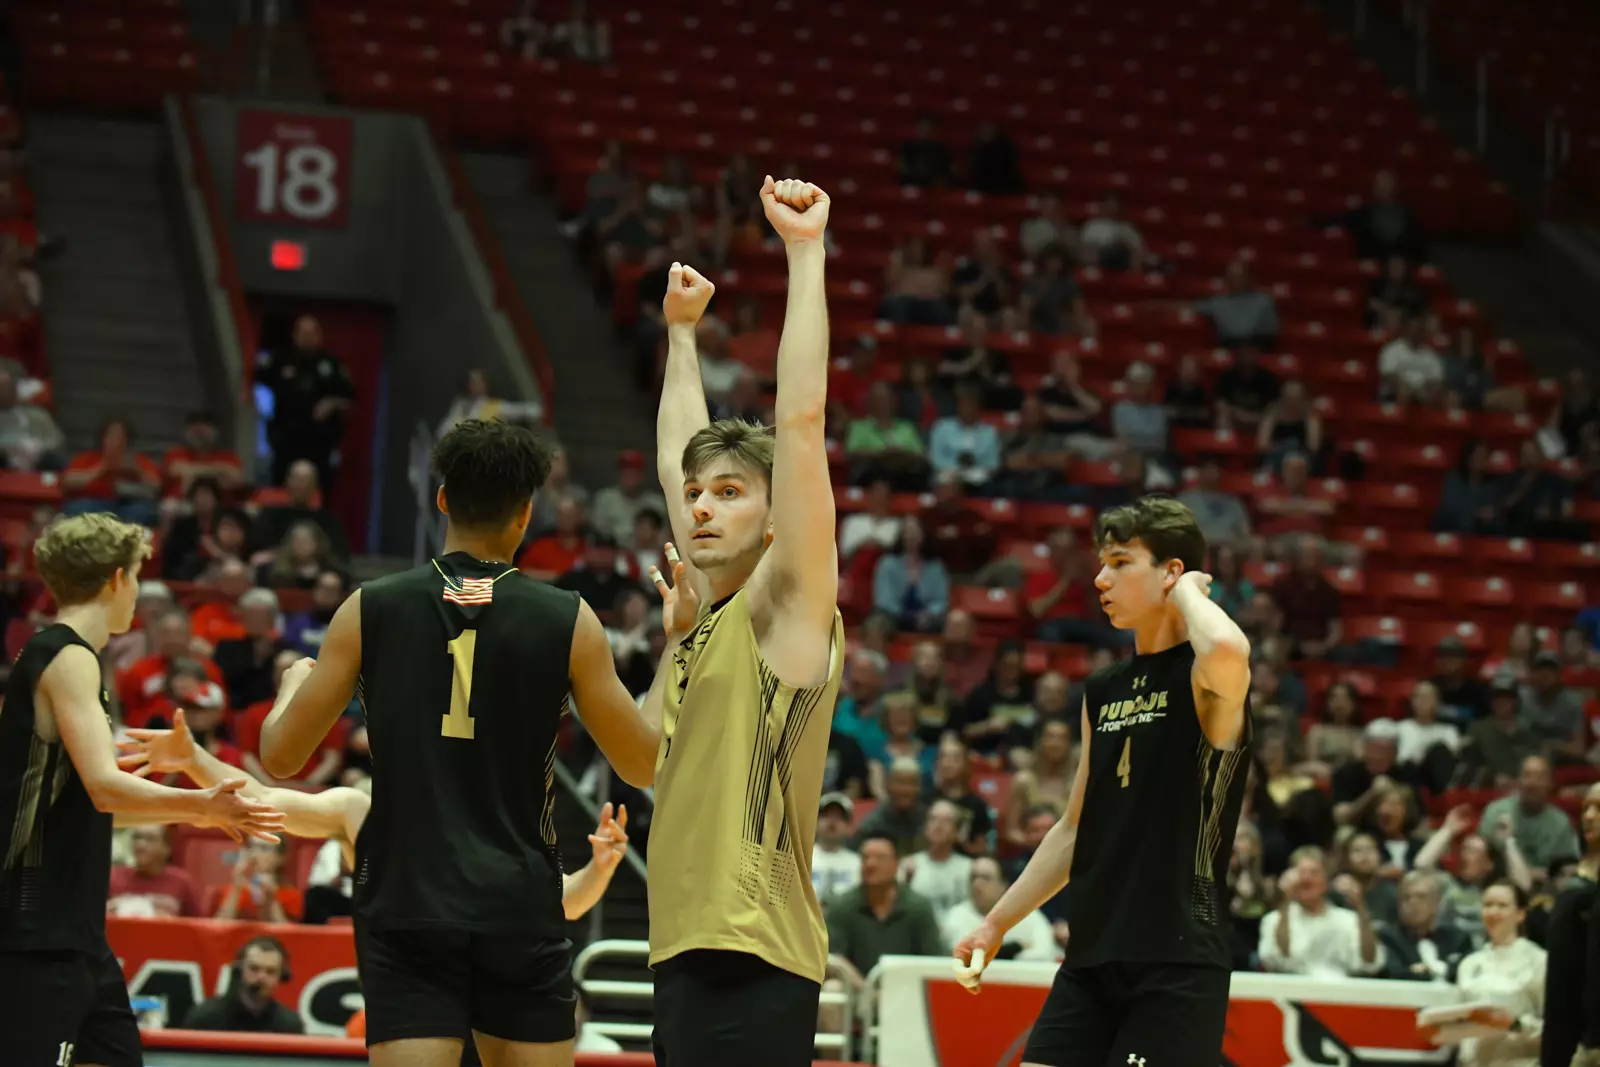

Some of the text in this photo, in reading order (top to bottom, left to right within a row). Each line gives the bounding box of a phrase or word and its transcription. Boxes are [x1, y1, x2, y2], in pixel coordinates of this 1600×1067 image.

[243, 142, 339, 220] 18
[441, 628, 477, 740] 1
[1116, 735, 1131, 788] 4
